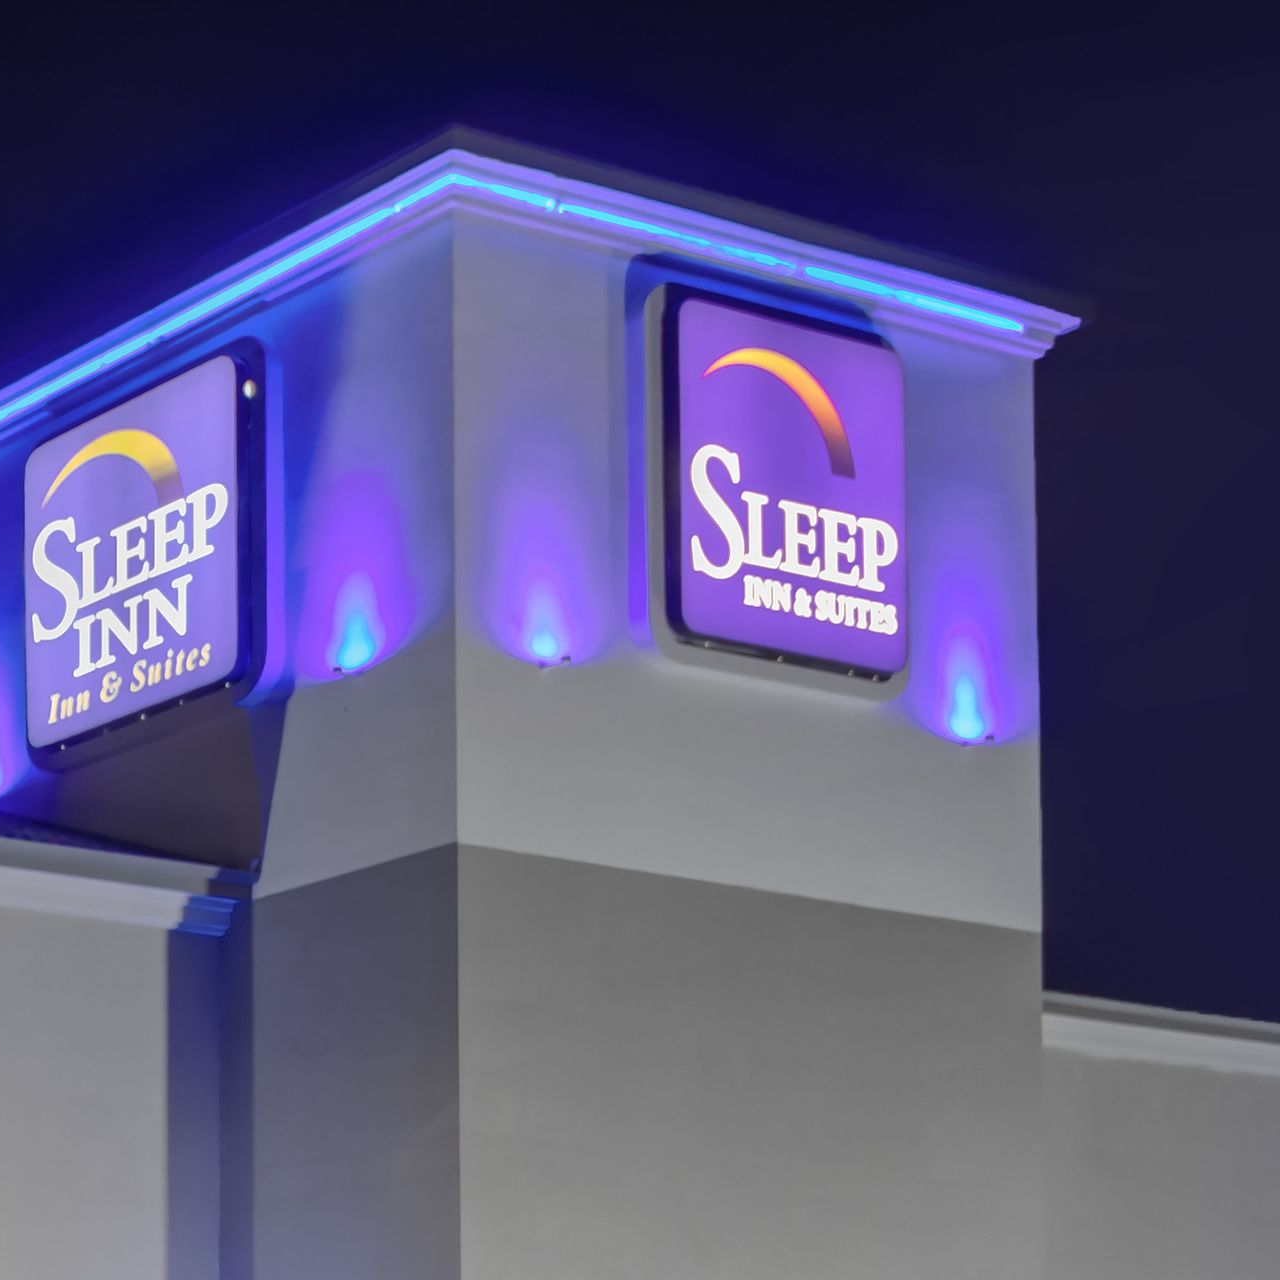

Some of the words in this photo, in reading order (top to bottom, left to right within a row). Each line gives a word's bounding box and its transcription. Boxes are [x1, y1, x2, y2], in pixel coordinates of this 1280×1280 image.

[32, 482, 229, 643] SLEEP
[691, 443, 899, 593] SLEEP
[73, 573, 194, 678] INN
[742, 574, 792, 613] INN
[793, 588, 812, 618] &
[814, 589, 899, 636] SUITES
[47, 692, 90, 725] Inn
[99, 671, 123, 703] &
[129, 642, 212, 693] Suites
